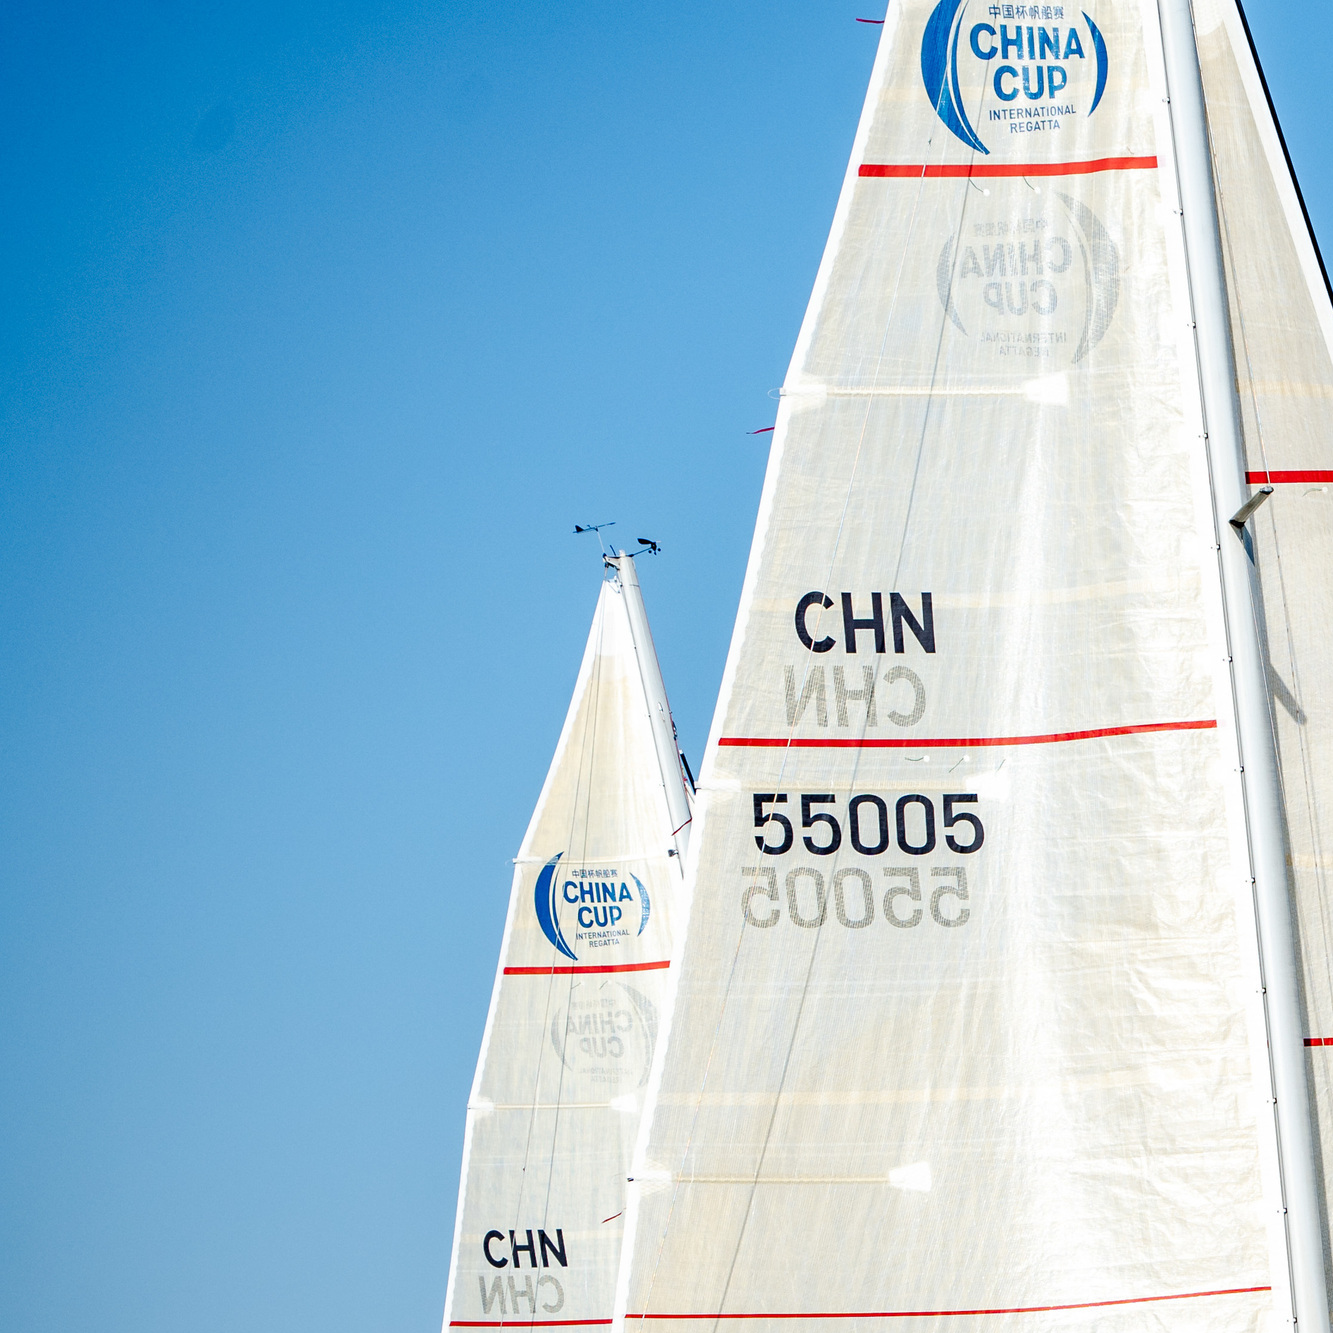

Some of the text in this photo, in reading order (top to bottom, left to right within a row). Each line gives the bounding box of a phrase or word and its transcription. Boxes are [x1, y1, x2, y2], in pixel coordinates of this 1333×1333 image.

[988, 4, 1064, 20] 中国杯帆船赛
[970, 22, 1085, 60] CHINA
[993, 65, 1067, 101] CUP
[989, 104, 1077, 121] INTERNATIONAL
[1010, 119, 1060, 134] REGATTA
[794, 591, 937, 654] CHN
[752, 793, 985, 856] 55005
[563, 880, 634, 904] CHINA
[578, 906, 622, 929] CUP
[483, 1228, 568, 1269] CHN
